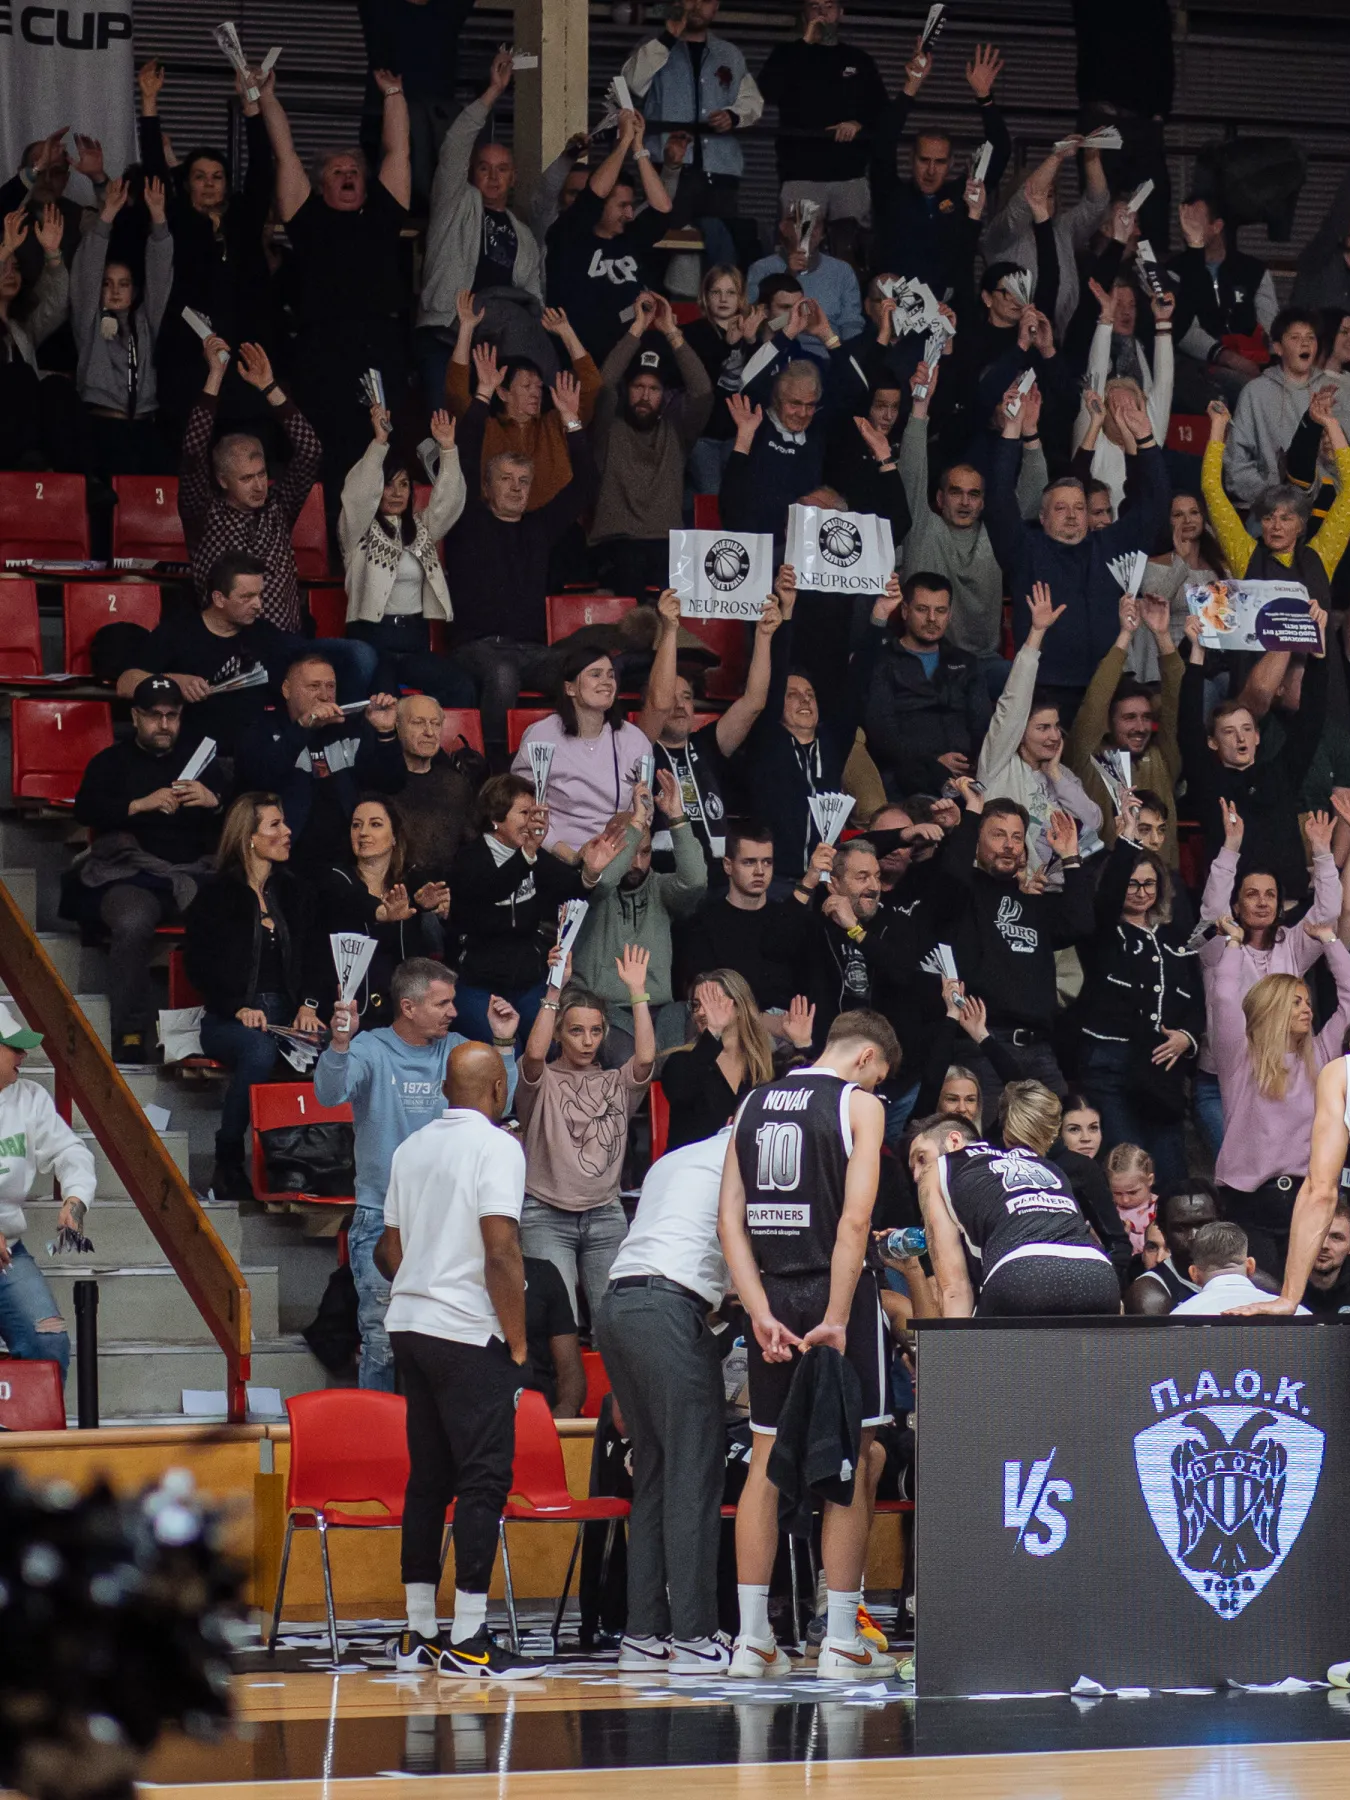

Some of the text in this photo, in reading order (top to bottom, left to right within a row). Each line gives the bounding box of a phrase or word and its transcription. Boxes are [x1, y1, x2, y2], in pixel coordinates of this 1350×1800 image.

[21, 5, 133, 50] CUP
[35, 482, 44, 500] 2
[155, 487, 165, 505] 3
[800, 572, 887, 590] NEÚPROSNÍ
[108, 594, 117, 612] 2
[54, 712, 62, 731] 1
[402, 1081, 432, 1095] 1973
[297, 1095, 306, 1115] 1
[762, 1087, 815, 1111] NOVÁK
[756, 1121, 803, 1191] 10
[748, 1210, 804, 1221] PARTNERS
[1004, 1446, 1073, 1557] VS
